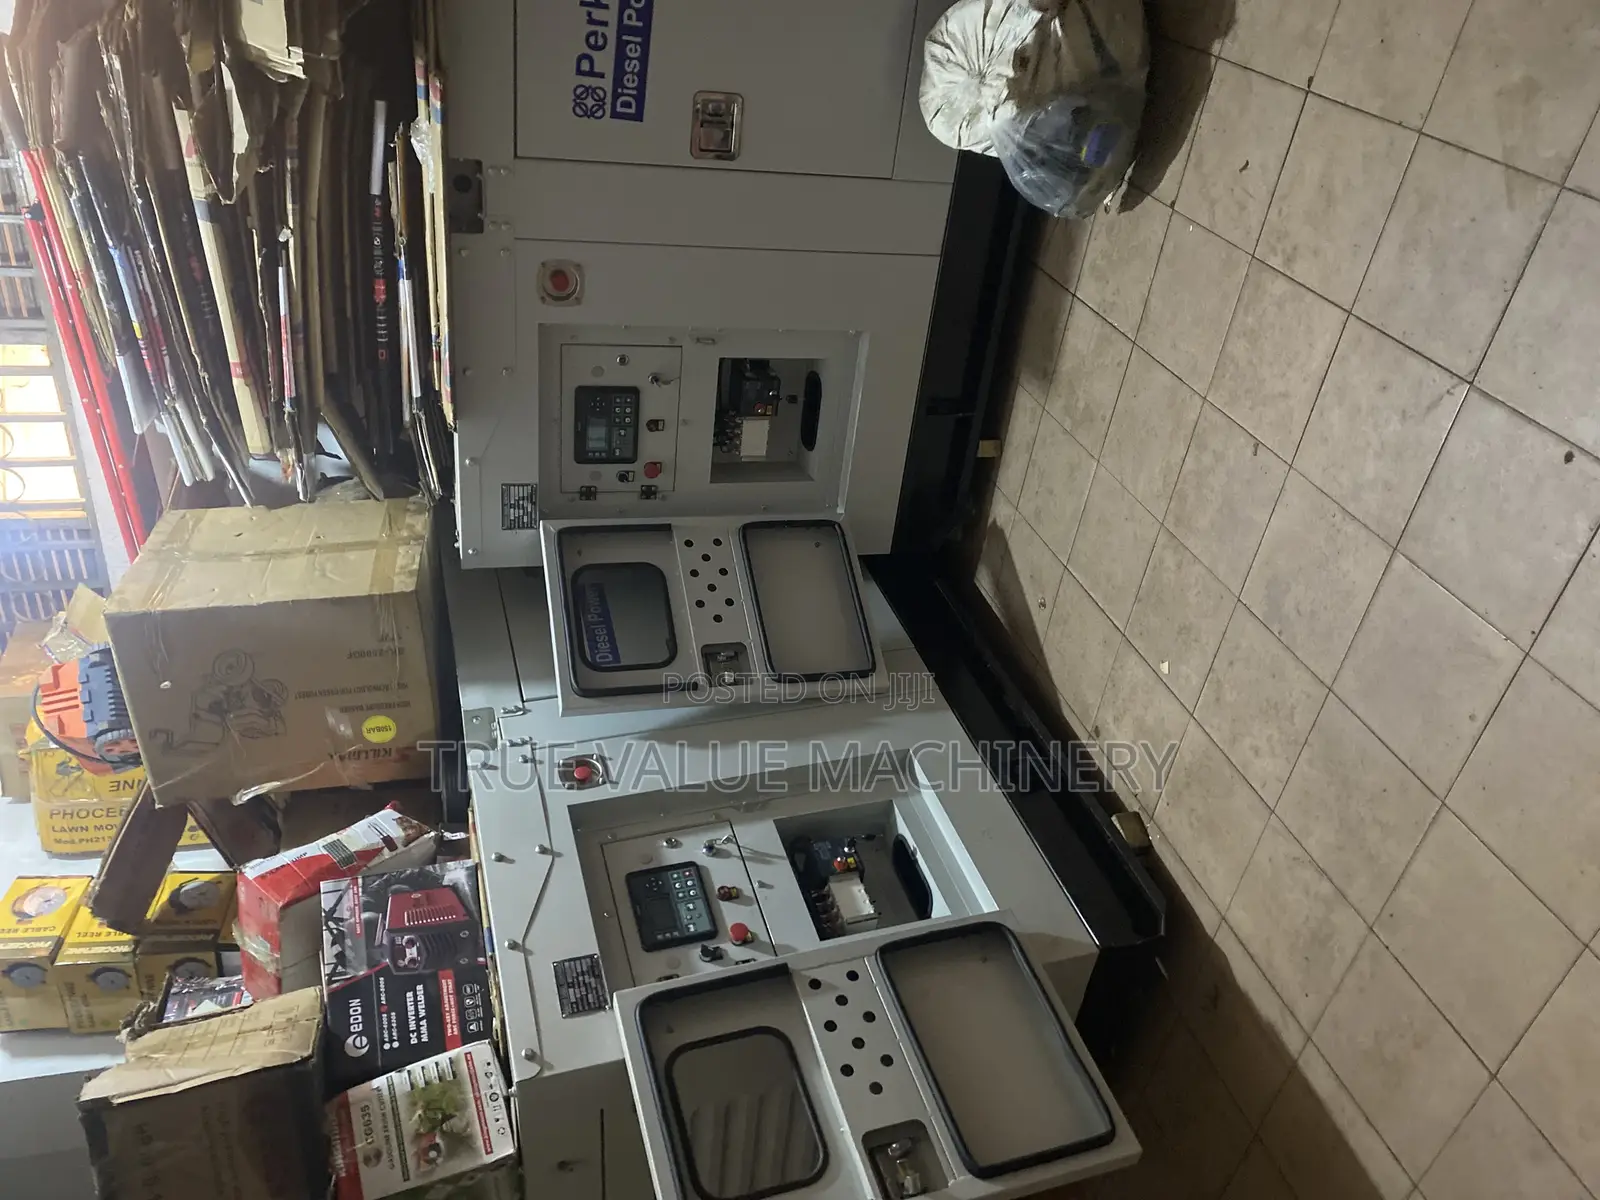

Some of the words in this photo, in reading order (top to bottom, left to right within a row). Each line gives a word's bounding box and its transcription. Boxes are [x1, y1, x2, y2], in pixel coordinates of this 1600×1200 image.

[616, 35, 642, 113] Diesel
[595, 624, 613, 662] Diesel
[366, 724, 392, 735] 150BAR
[52, 825, 89, 833] LAWN
[406, 991, 416, 1031] INVERTER
[416, 984, 426, 1018] WELDER
[410, 1032, 418, 1044] DC
[420, 1019, 429, 1042] MMA
